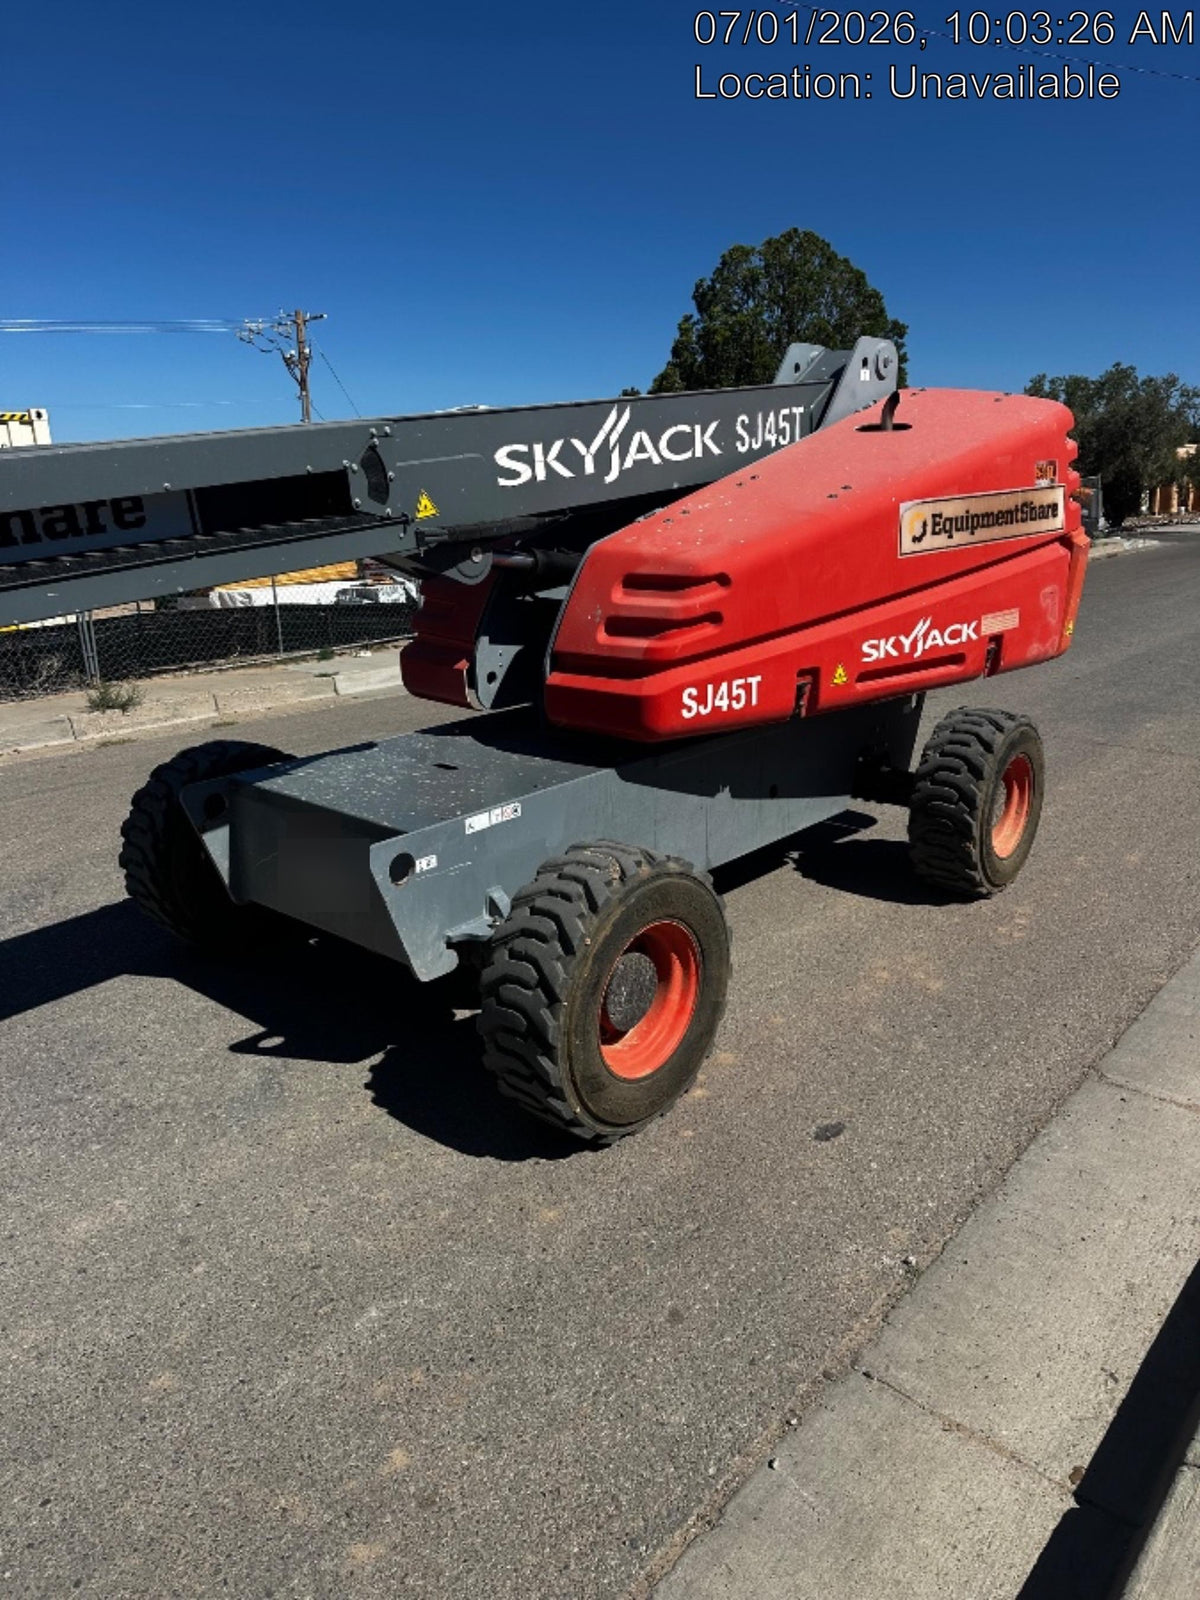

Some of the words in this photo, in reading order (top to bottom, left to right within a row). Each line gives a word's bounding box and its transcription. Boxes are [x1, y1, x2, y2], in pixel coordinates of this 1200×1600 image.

[494, 404, 723, 486] SKYJACK
[735, 406, 805, 453] SJ45T
[931, 501, 1059, 540] EquipmentShare
[861, 616, 978, 662] SKYJACK
[681, 675, 762, 719] SJ45T
